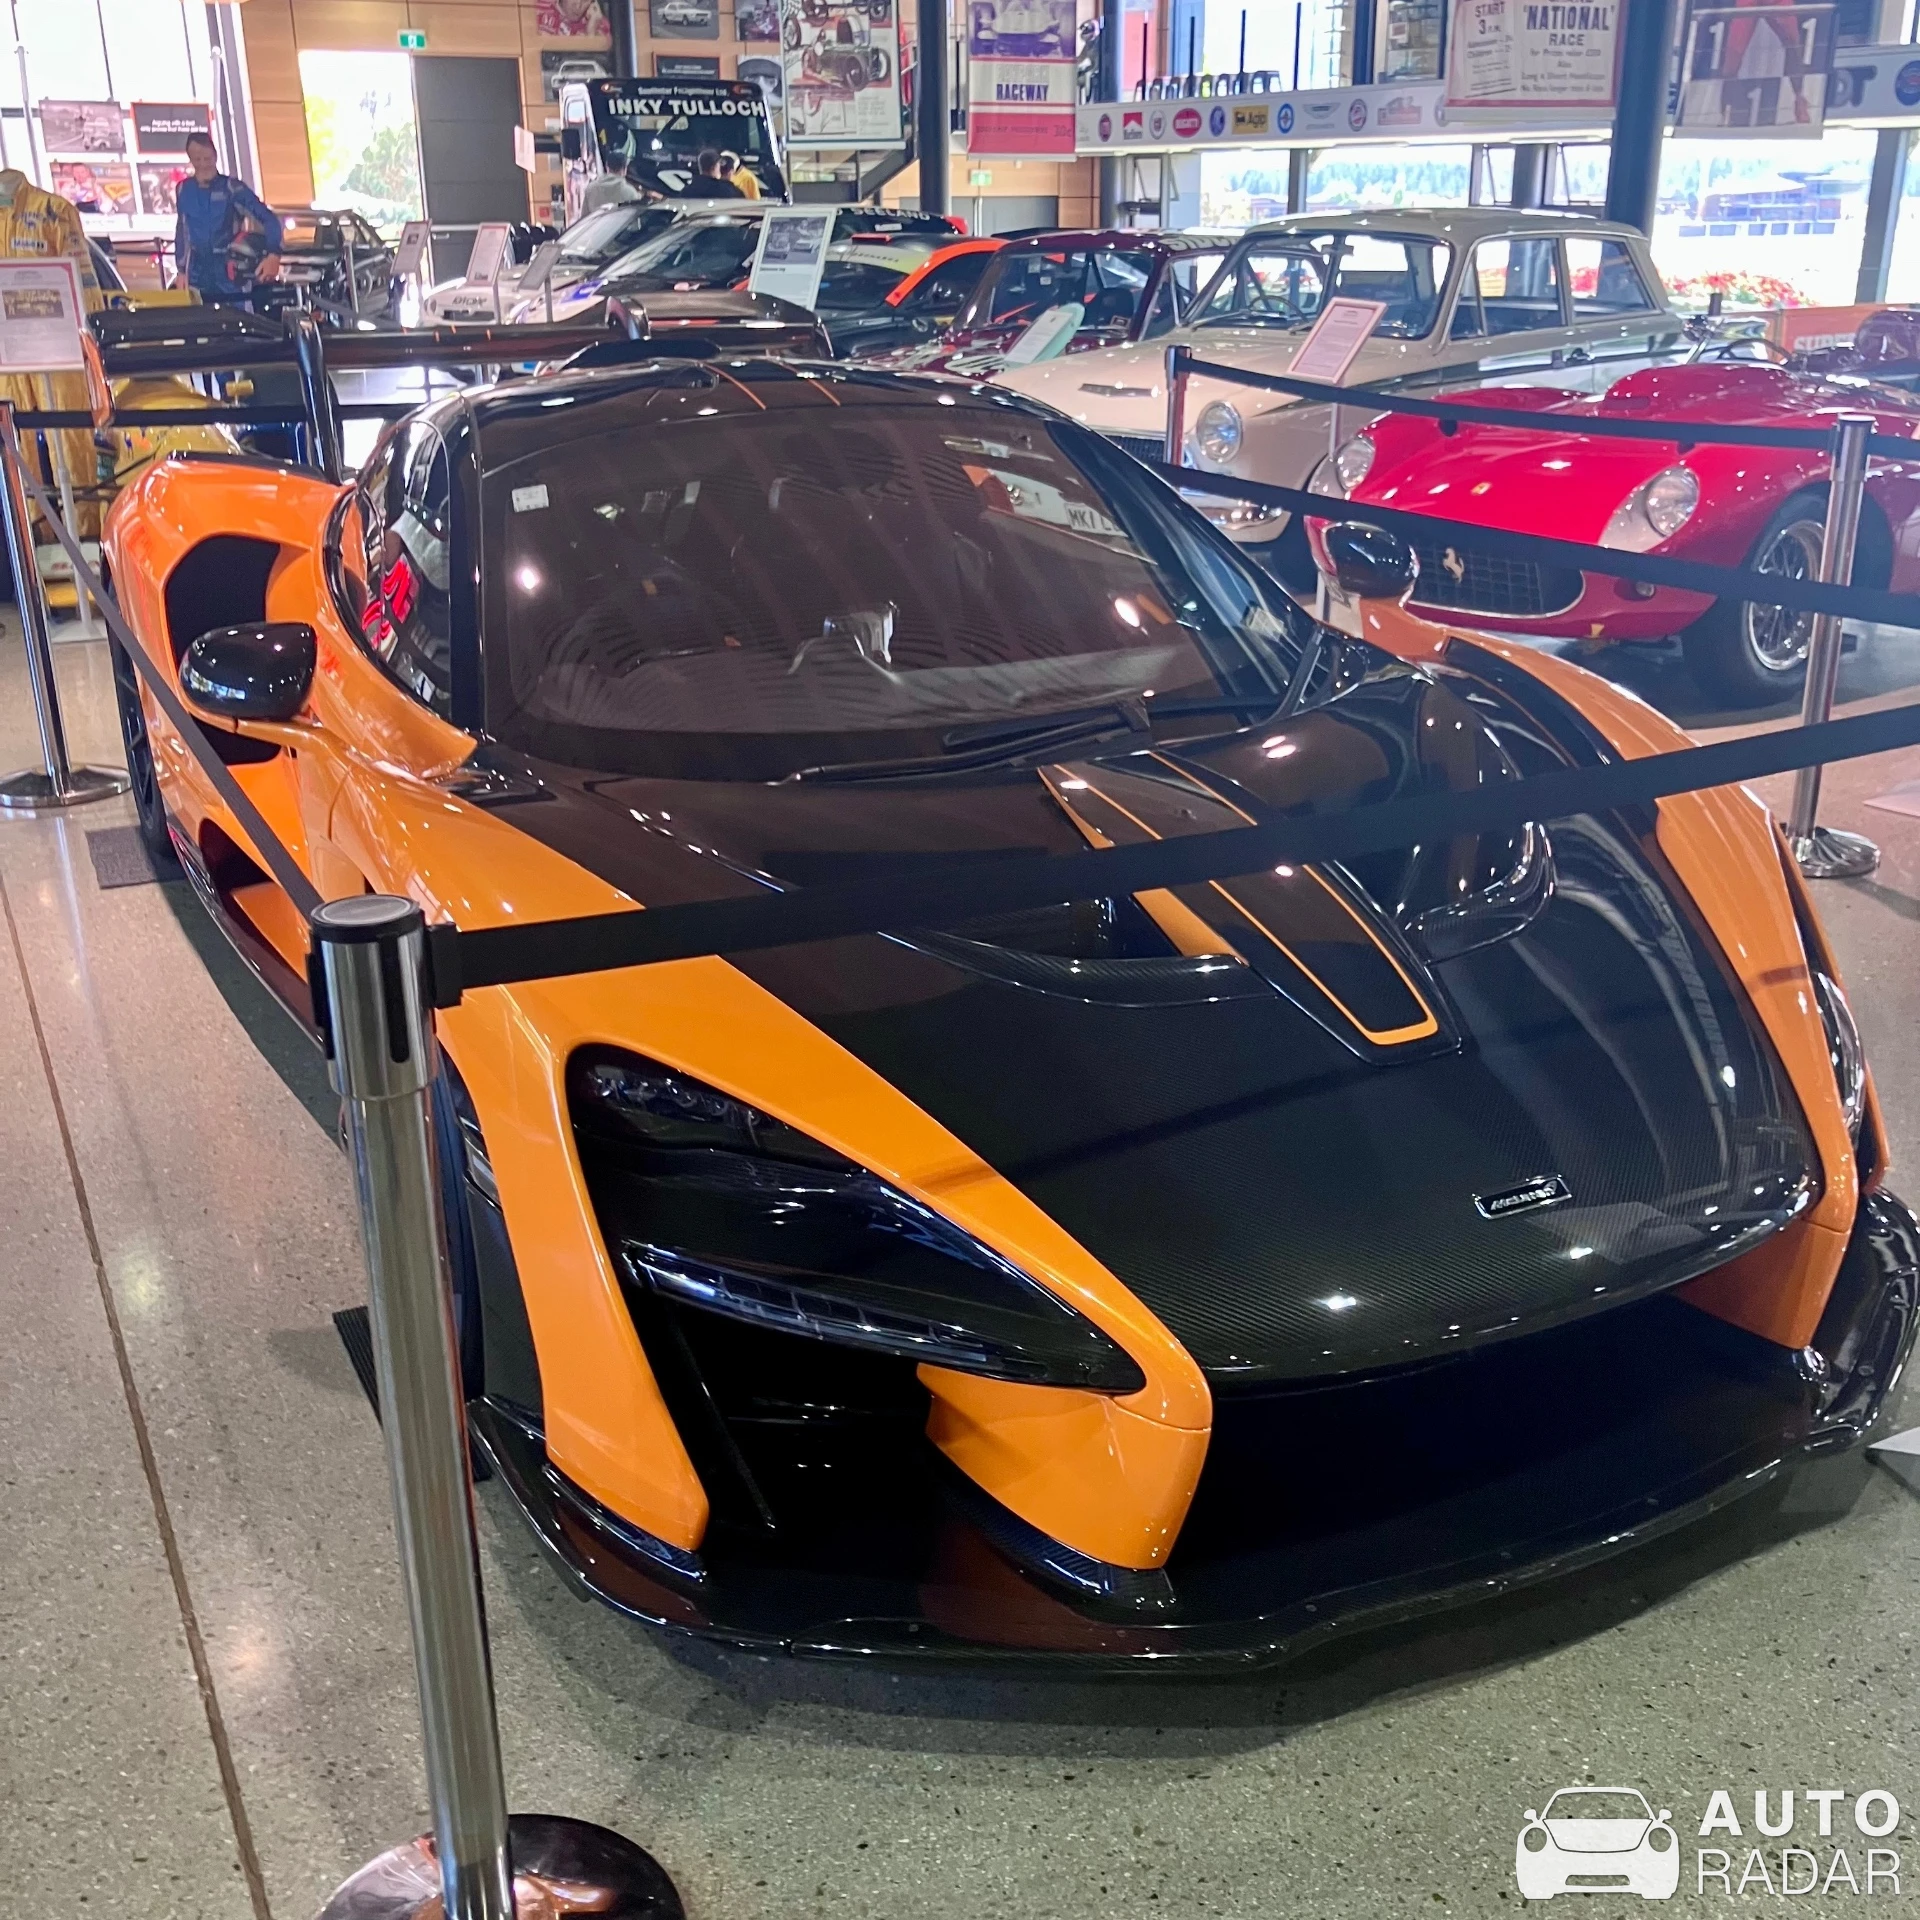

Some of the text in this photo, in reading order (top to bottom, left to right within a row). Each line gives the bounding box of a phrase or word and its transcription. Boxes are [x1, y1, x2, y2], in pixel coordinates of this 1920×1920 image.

[1475, 2, 1505, 18] START
[1549, 33, 1585, 46] RACE
[996, 83, 1049, 102] RACEWAY
[608, 98, 765, 117] INKY TULLOCH
